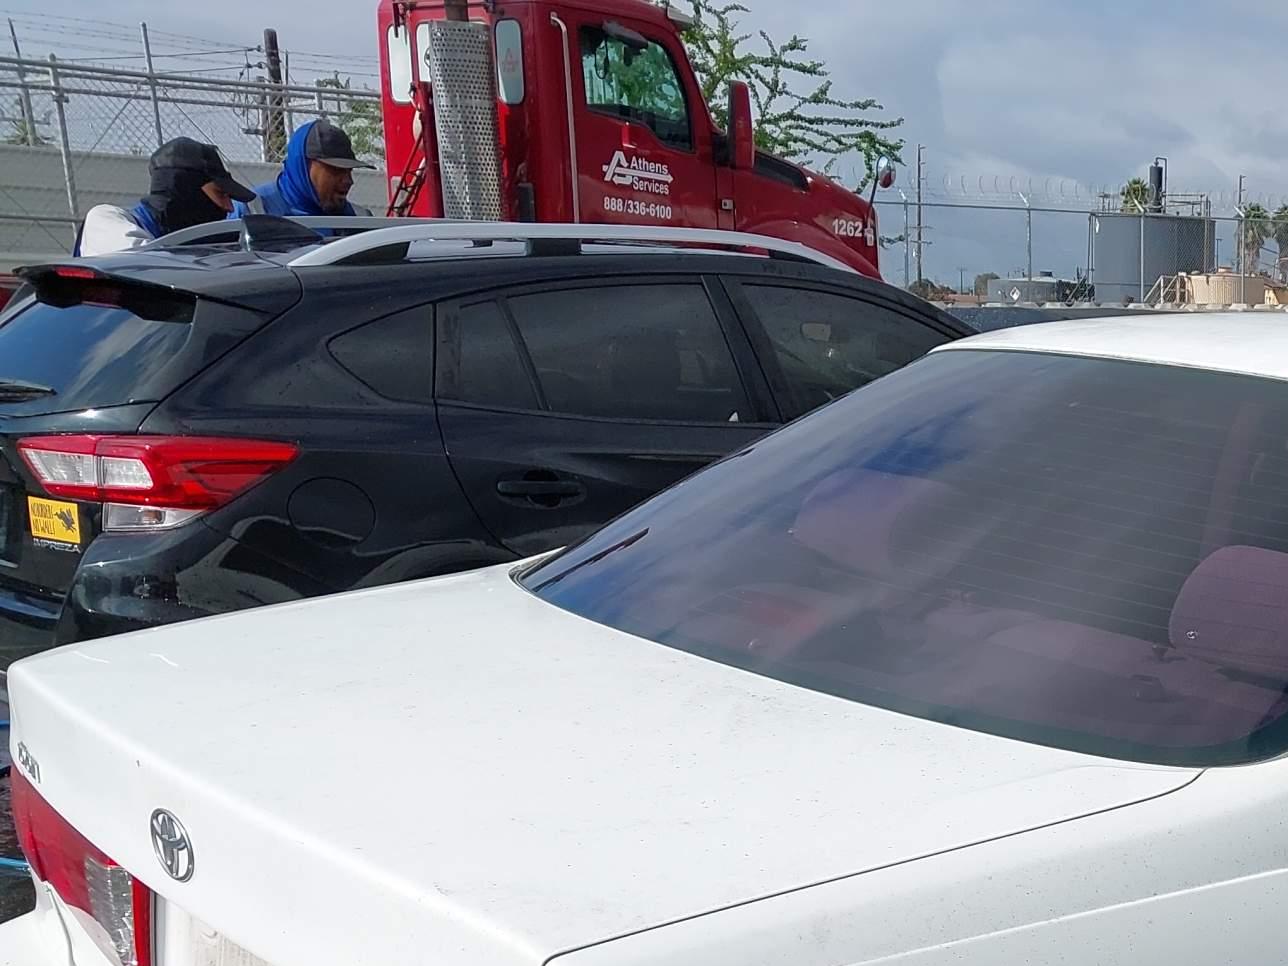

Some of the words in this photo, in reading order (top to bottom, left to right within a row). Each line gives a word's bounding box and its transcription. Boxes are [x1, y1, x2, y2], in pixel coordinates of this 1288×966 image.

[630, 155, 669, 175] Athens
[632, 176, 670, 195] Services
[603, 196, 672, 220] 888/336-6100
[832, 218, 863, 237] 1262
[33, 537, 81, 554] IMPREZA
